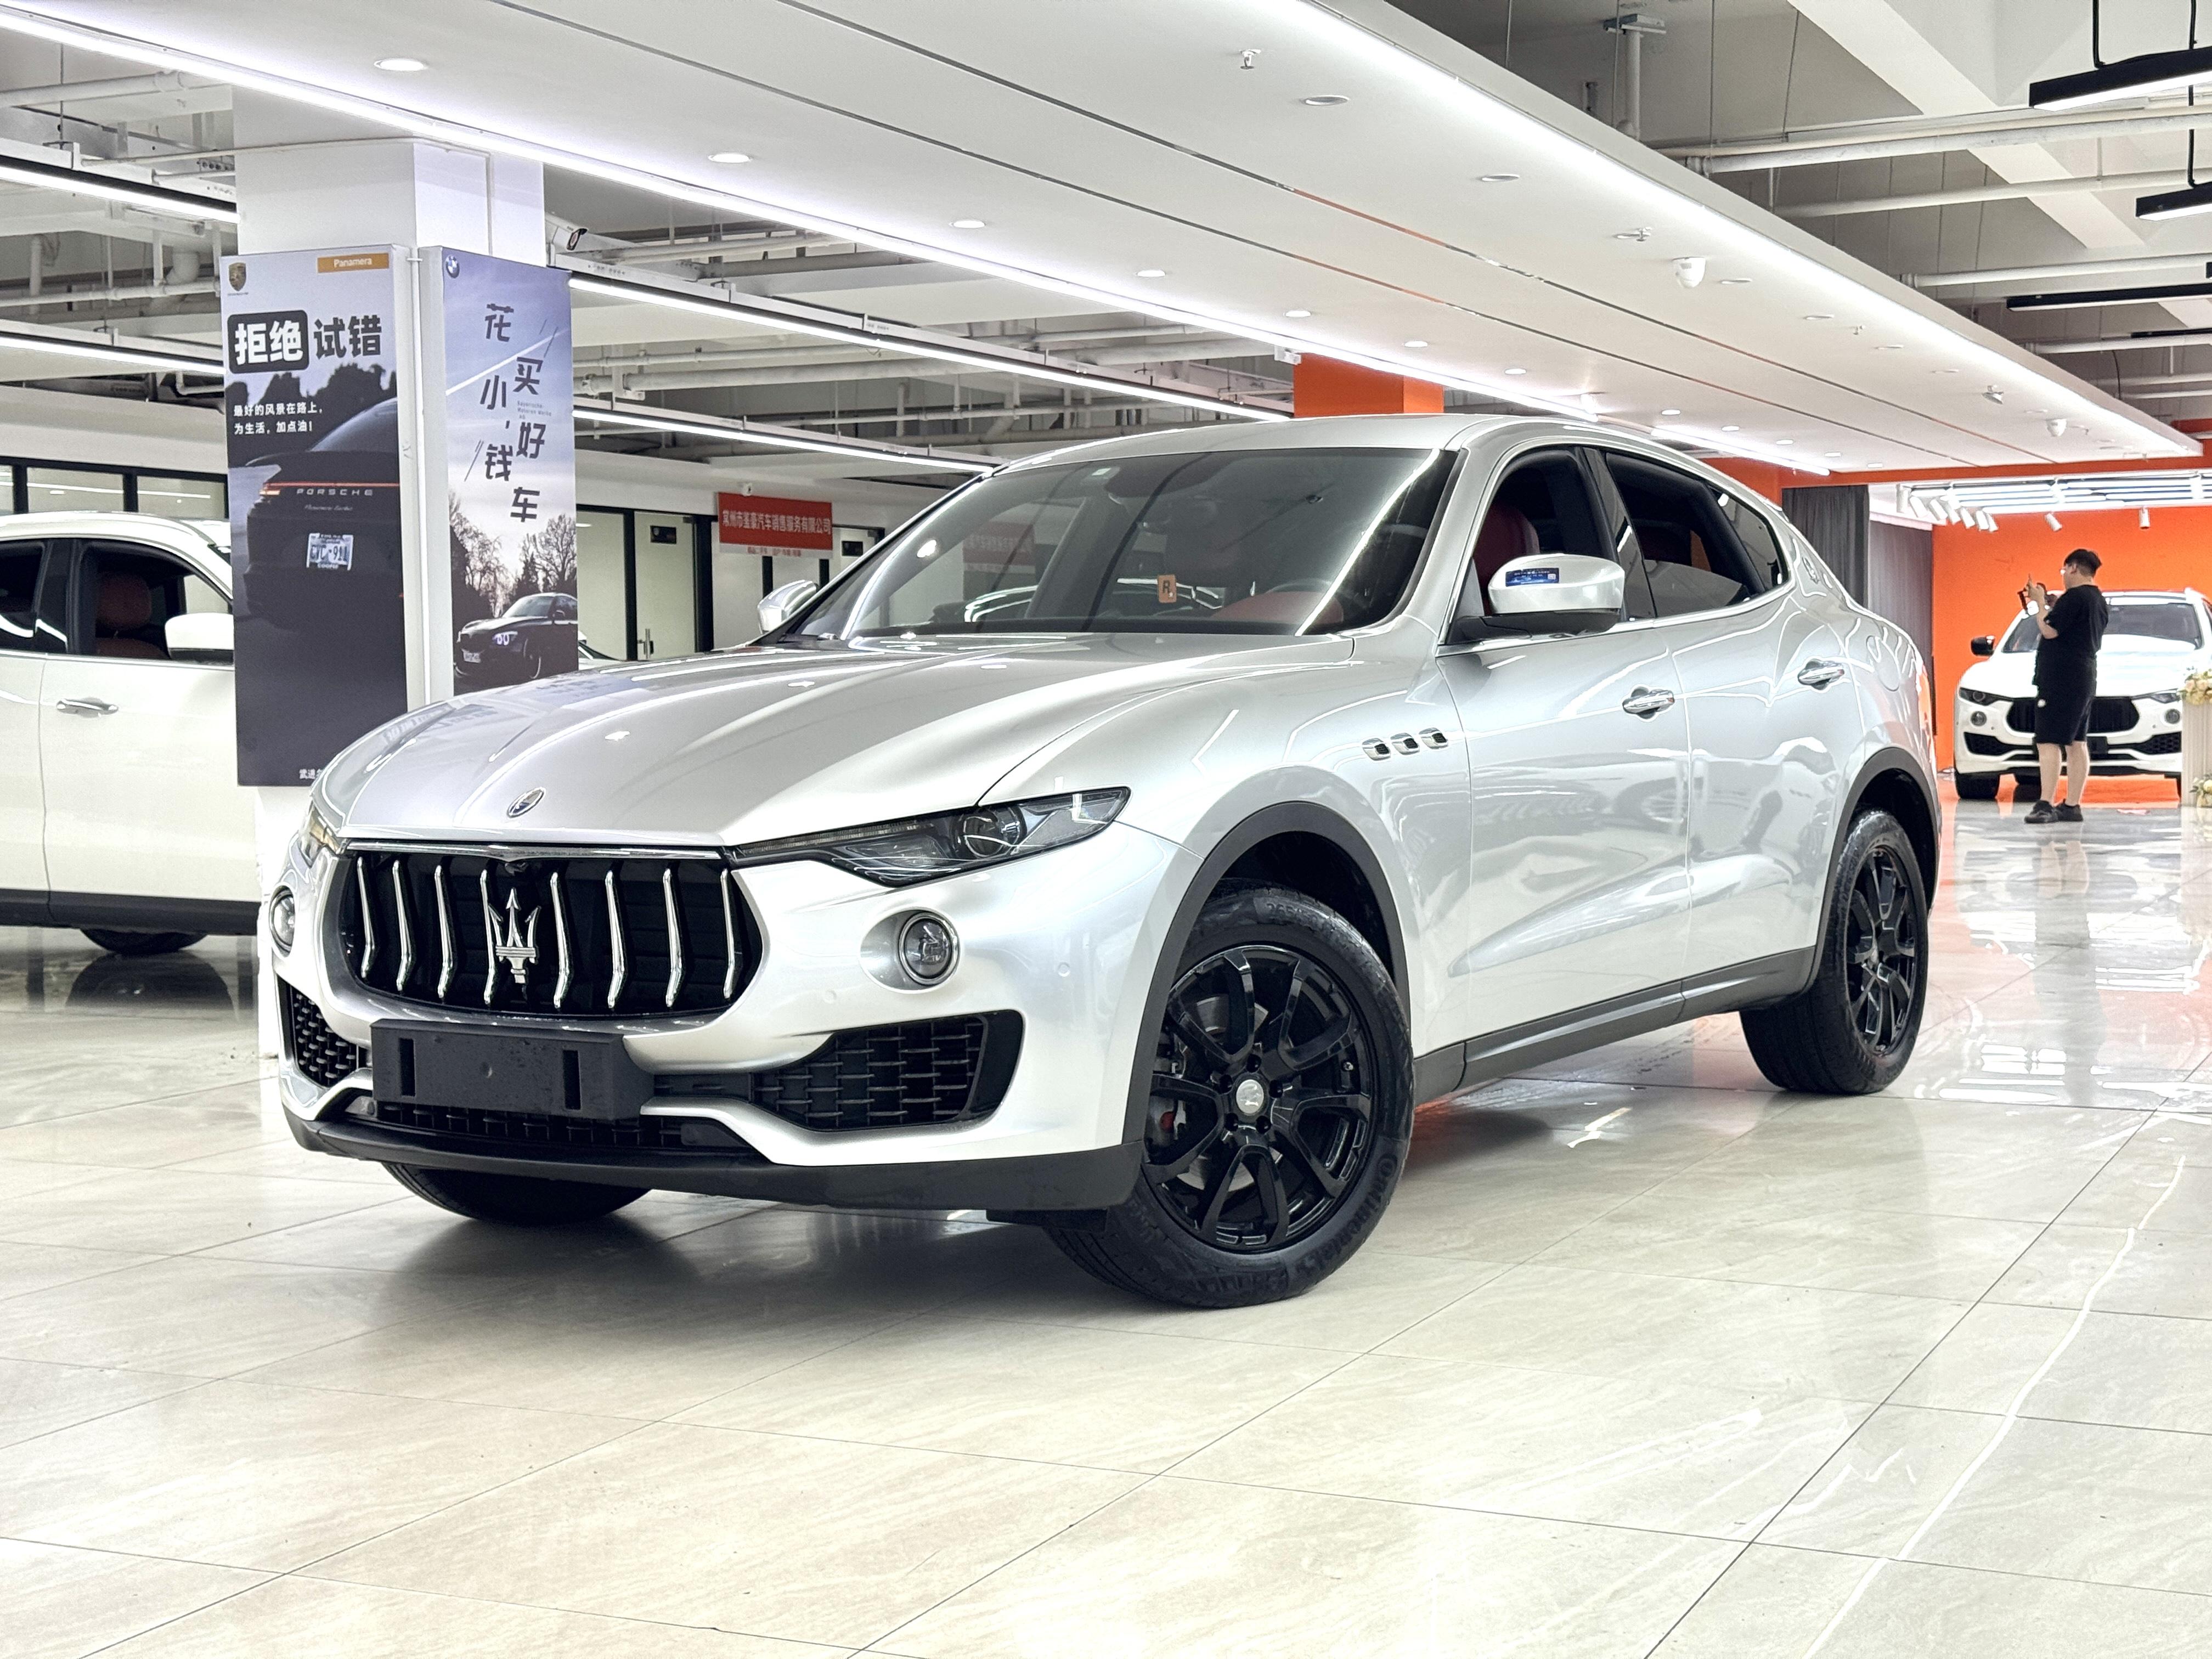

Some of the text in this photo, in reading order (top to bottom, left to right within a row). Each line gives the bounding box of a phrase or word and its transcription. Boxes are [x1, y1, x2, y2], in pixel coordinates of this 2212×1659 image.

[334, 257, 372, 268] Panamera
[235, 315, 381, 365] 拒绝 试错
